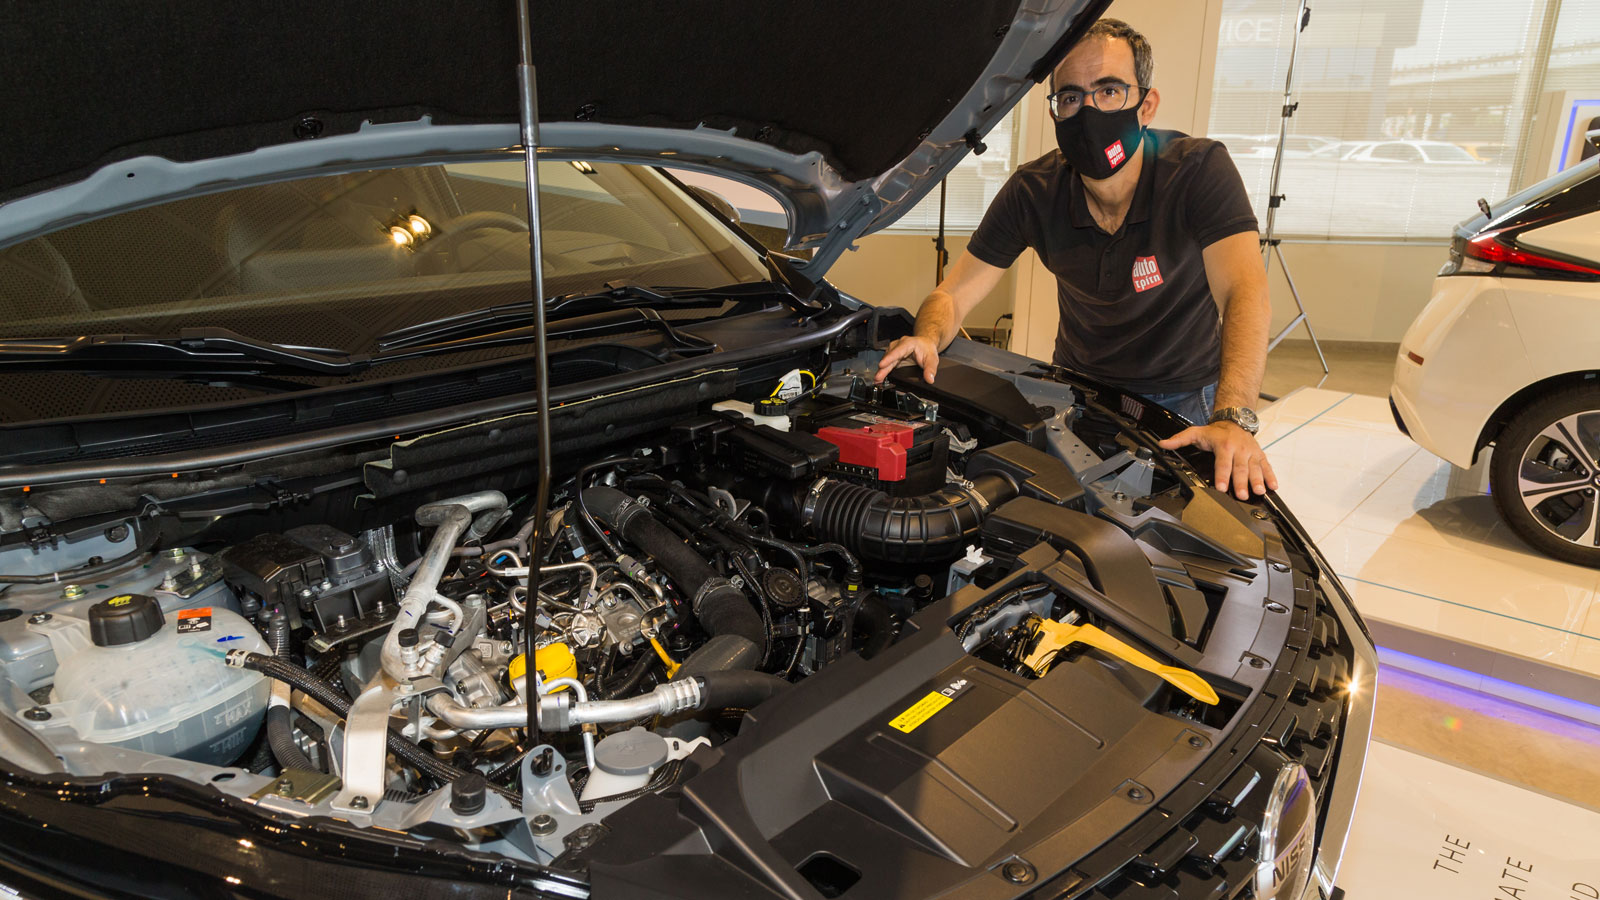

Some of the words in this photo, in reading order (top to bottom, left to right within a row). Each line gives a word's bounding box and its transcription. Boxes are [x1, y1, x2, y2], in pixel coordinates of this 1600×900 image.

[1107, 144, 1122, 159] auto
[1133, 258, 1157, 278] auto
[1433, 834, 1471, 874] THE
[1494, 856, 1533, 900] ATE
